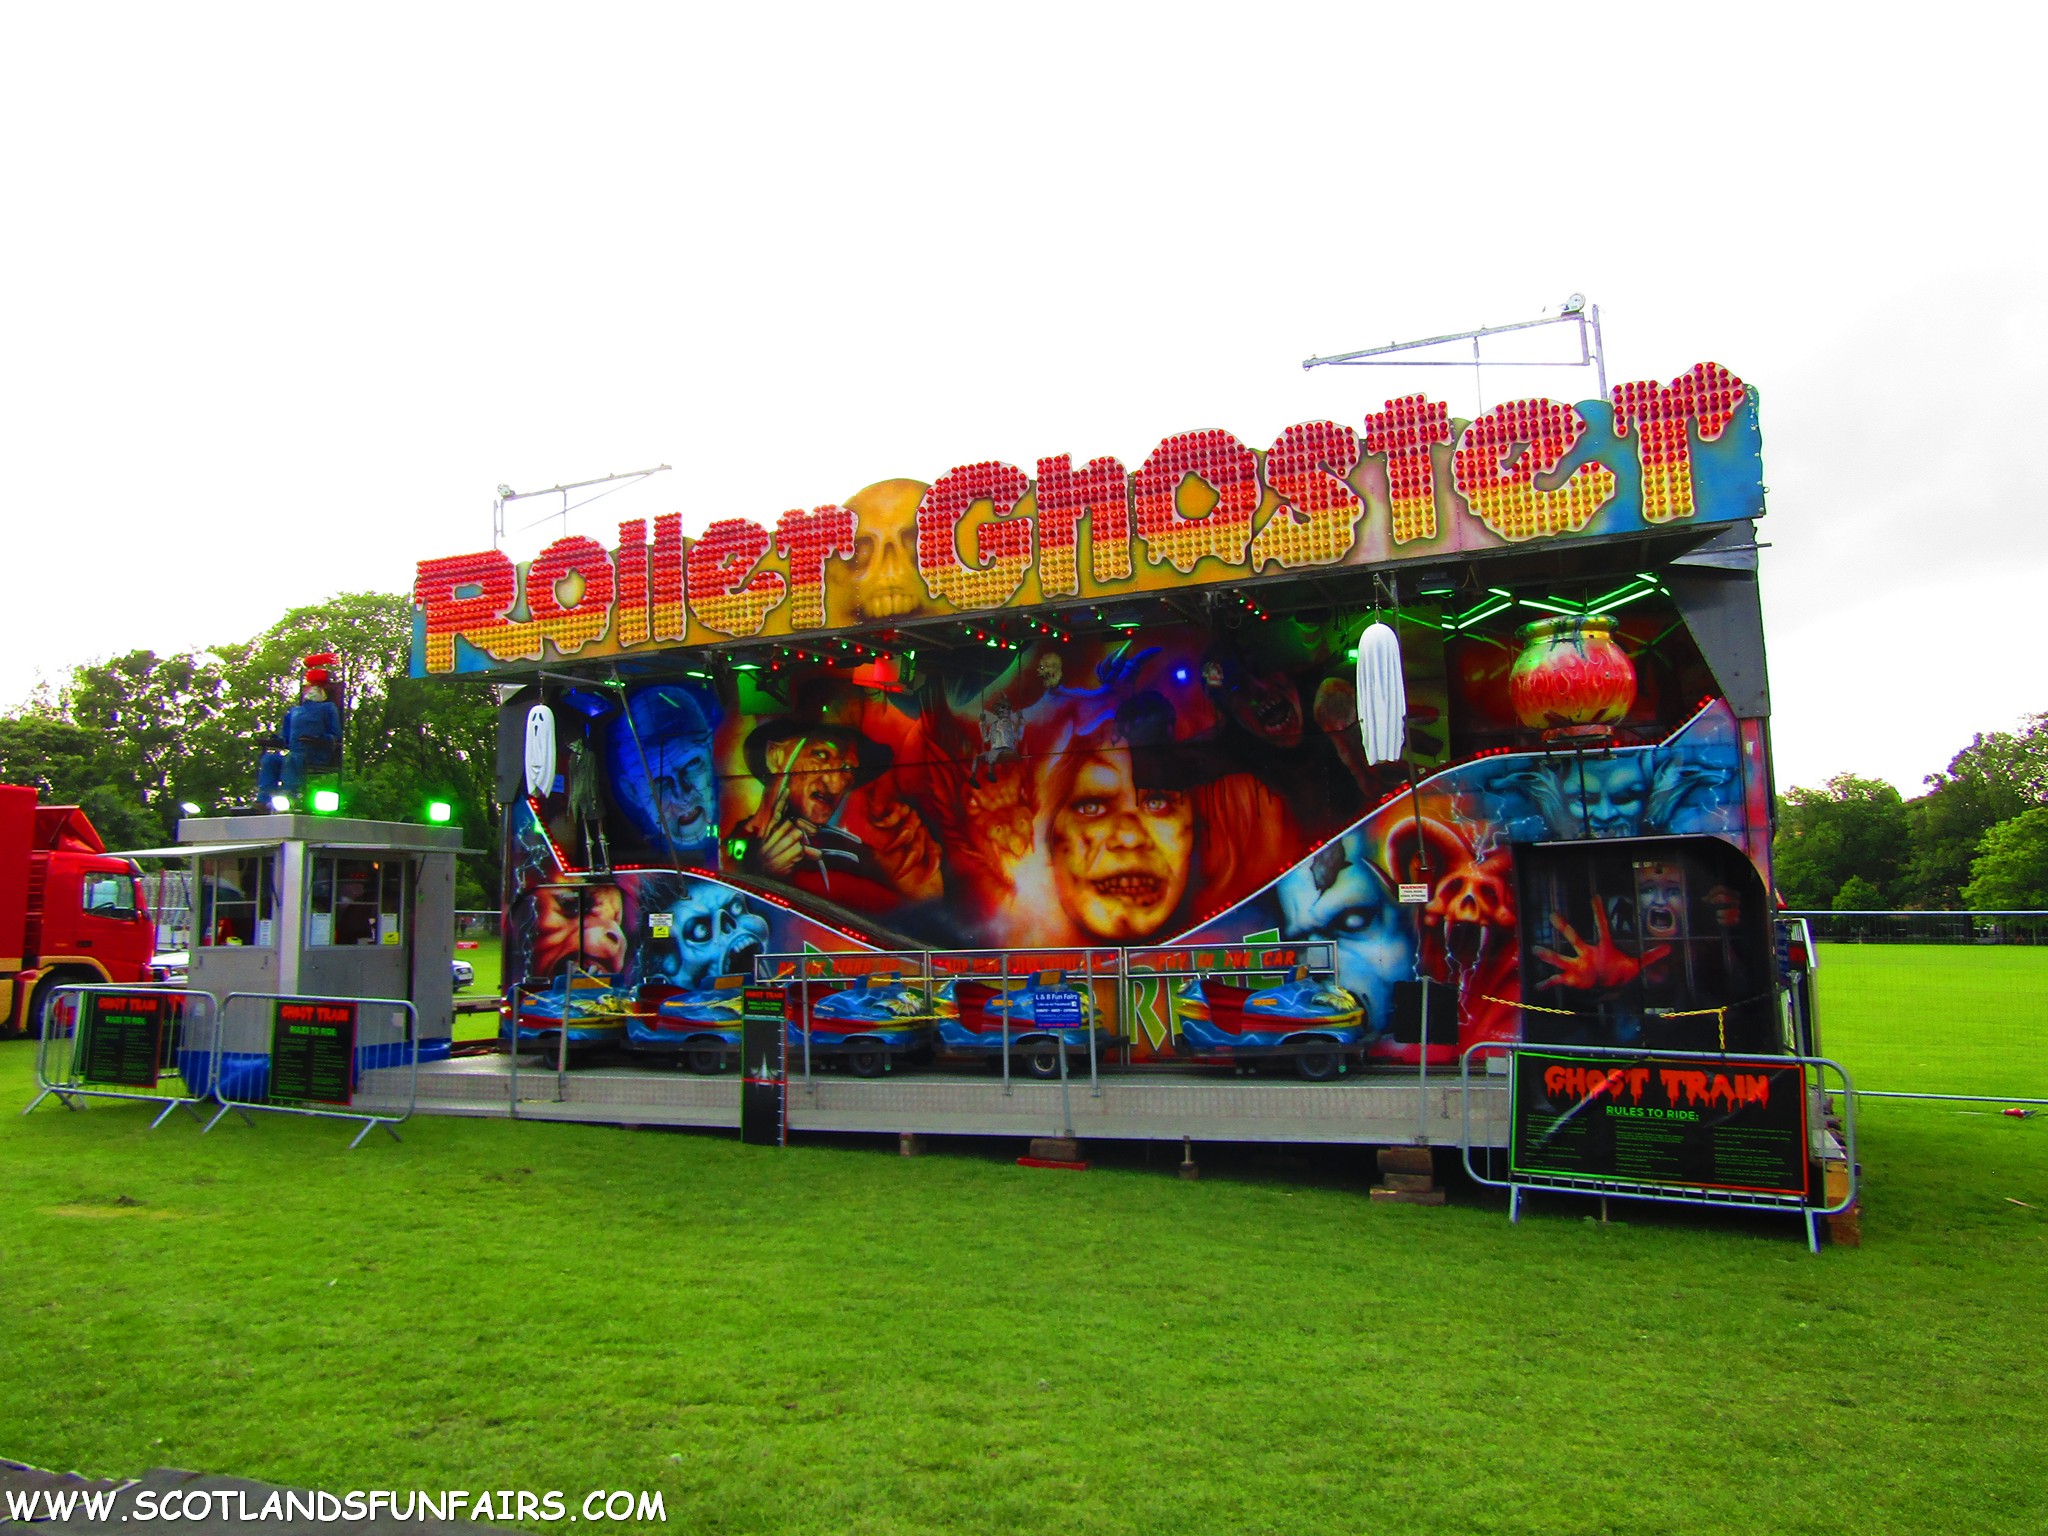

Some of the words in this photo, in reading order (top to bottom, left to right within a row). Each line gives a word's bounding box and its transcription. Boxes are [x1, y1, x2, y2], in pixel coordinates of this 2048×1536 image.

[415, 504, 858, 674] Roller
[917, 362, 1746, 611] Ghoster
[1264, 950, 1296, 967] CAR
[281, 1005, 315, 1022] GHOST
[316, 1006, 350, 1023] TRAIN
[289, 1025, 310, 1035] RULES
[1544, 1065, 1649, 1106] GHOST
[1659, 1068, 1770, 1112] TRAIN
[1606, 1105, 1645, 1118] RULES
[1647, 1107, 1665, 1118] TO
[1666, 1109, 1700, 1121] RIDE:
